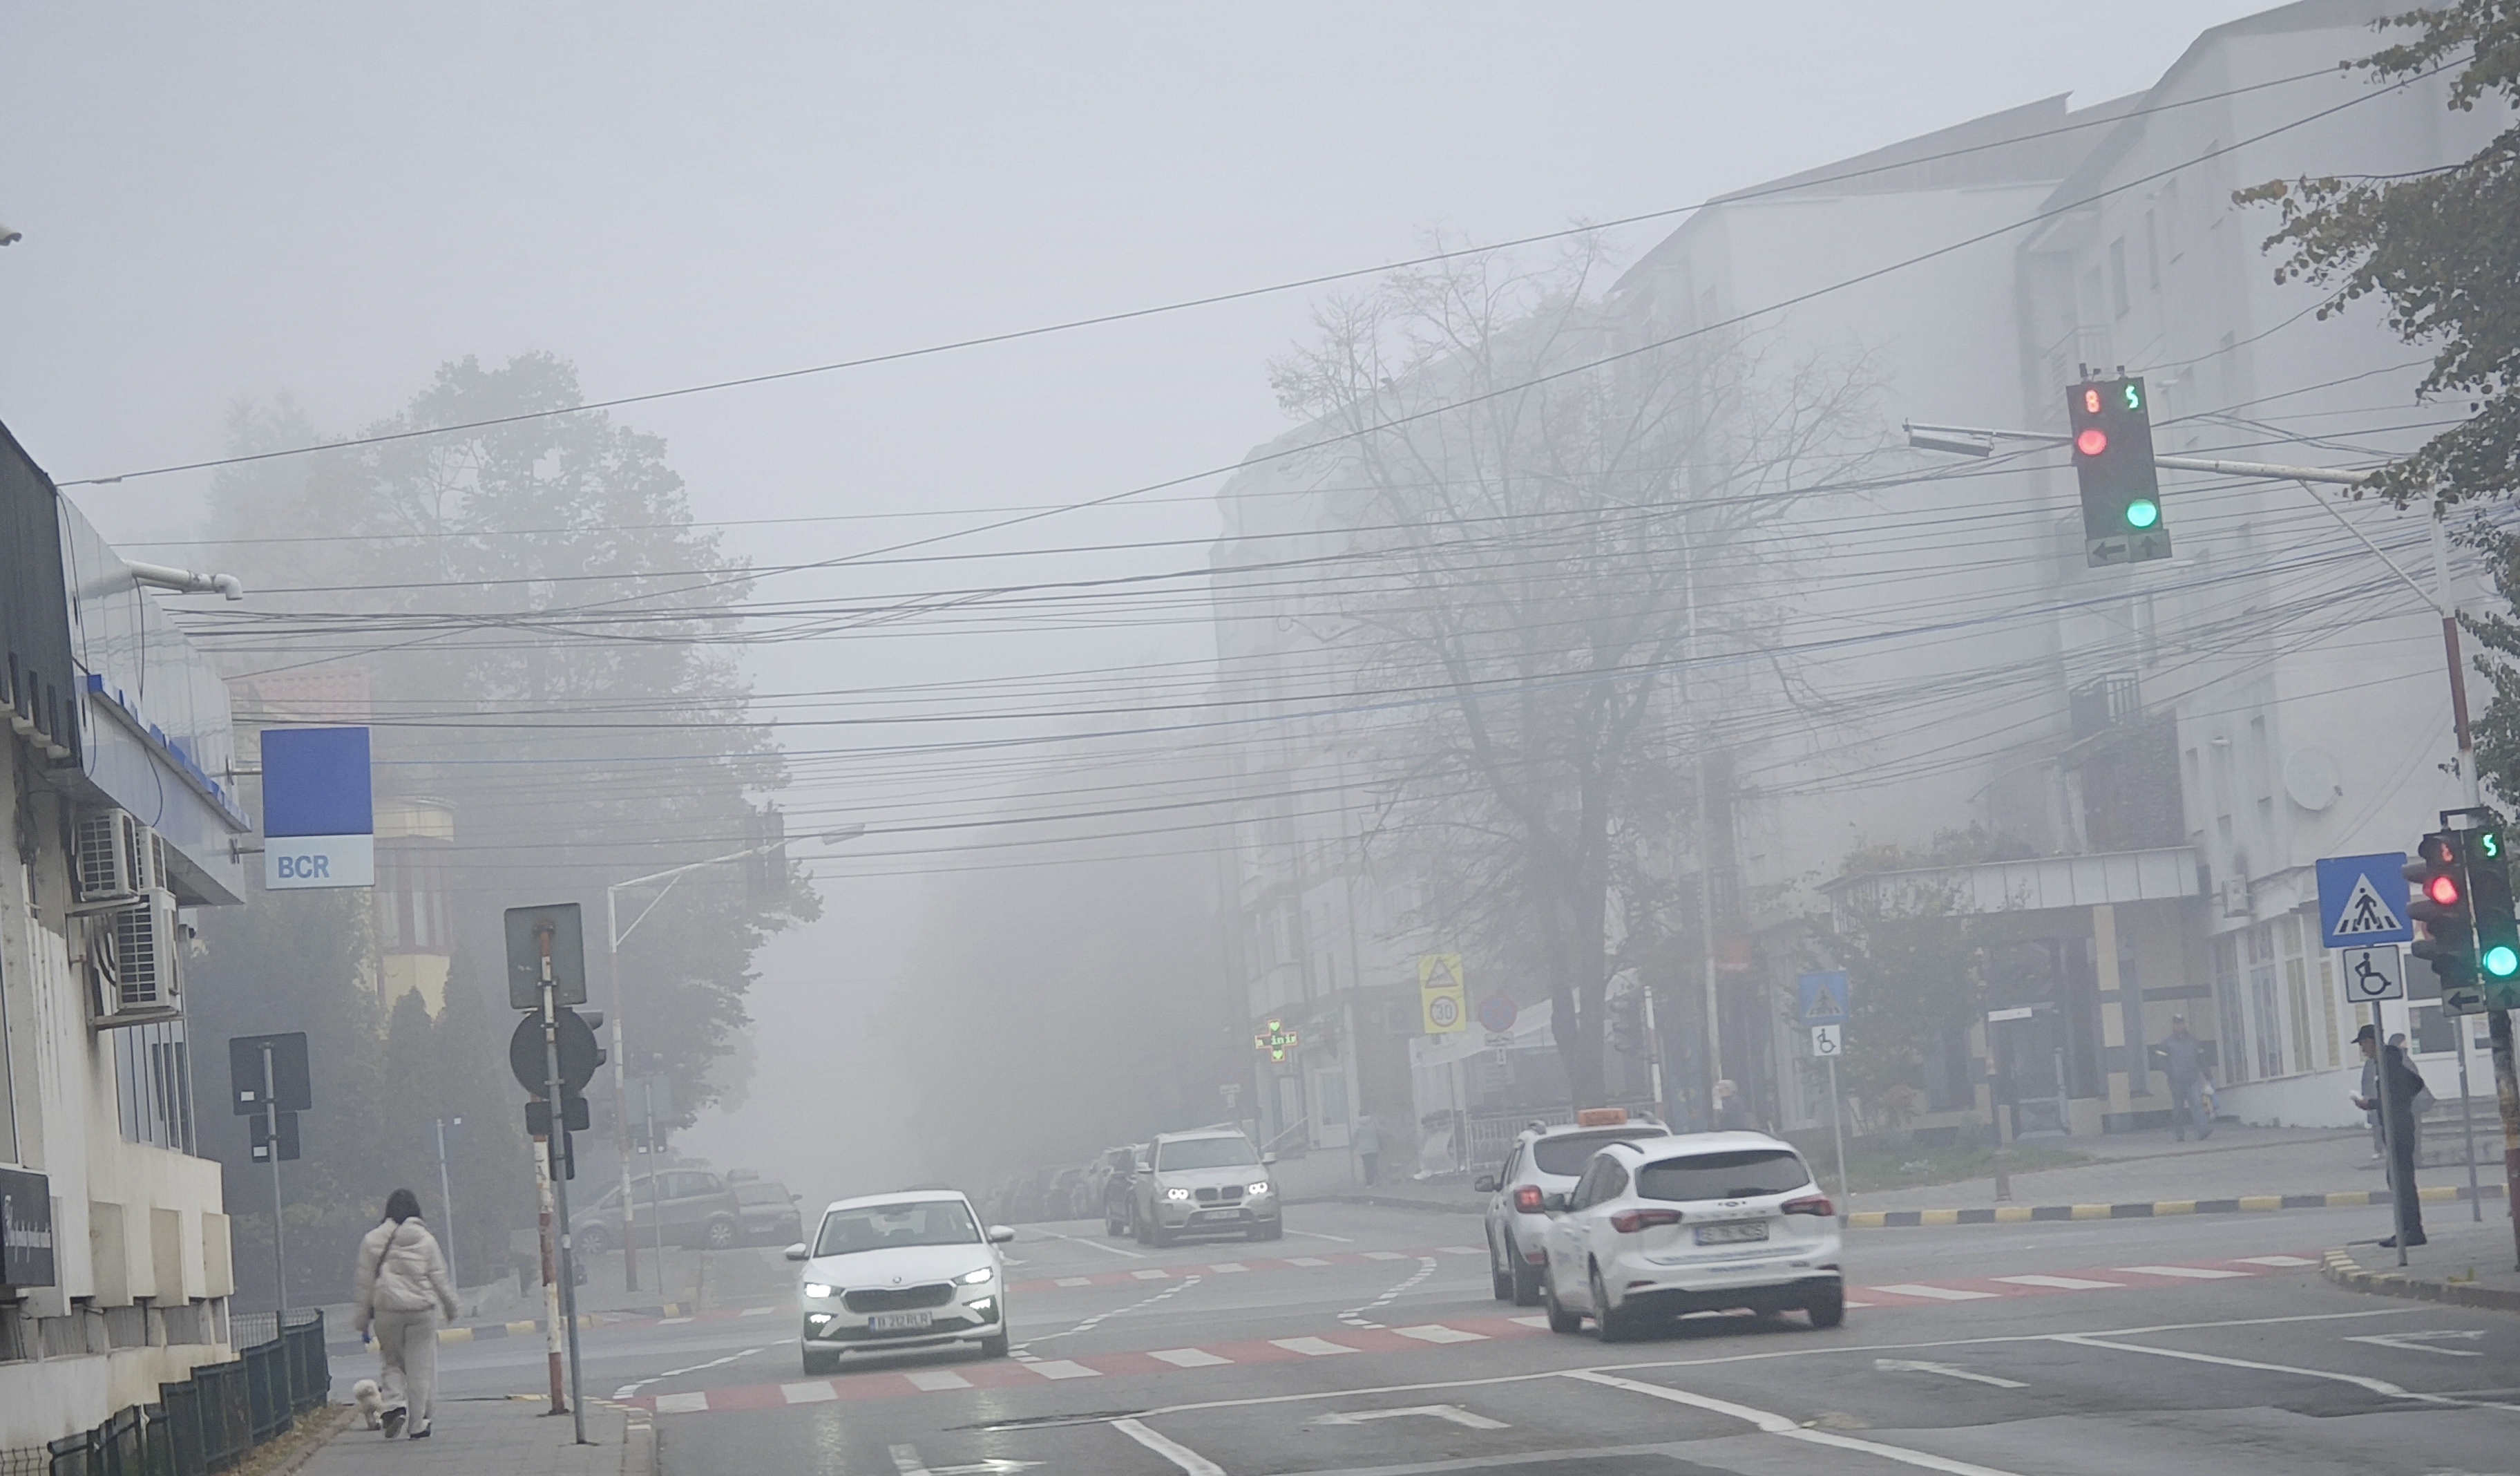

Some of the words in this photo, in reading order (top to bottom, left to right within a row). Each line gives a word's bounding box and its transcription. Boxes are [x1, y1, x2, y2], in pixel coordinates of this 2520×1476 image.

[2085, 389, 2100, 413] 8
[2126, 385, 2139, 408] 5
[2483, 833, 2497, 857] 5
[278, 855, 330, 878] BCR
[1436, 1004, 1453, 1021] 30
